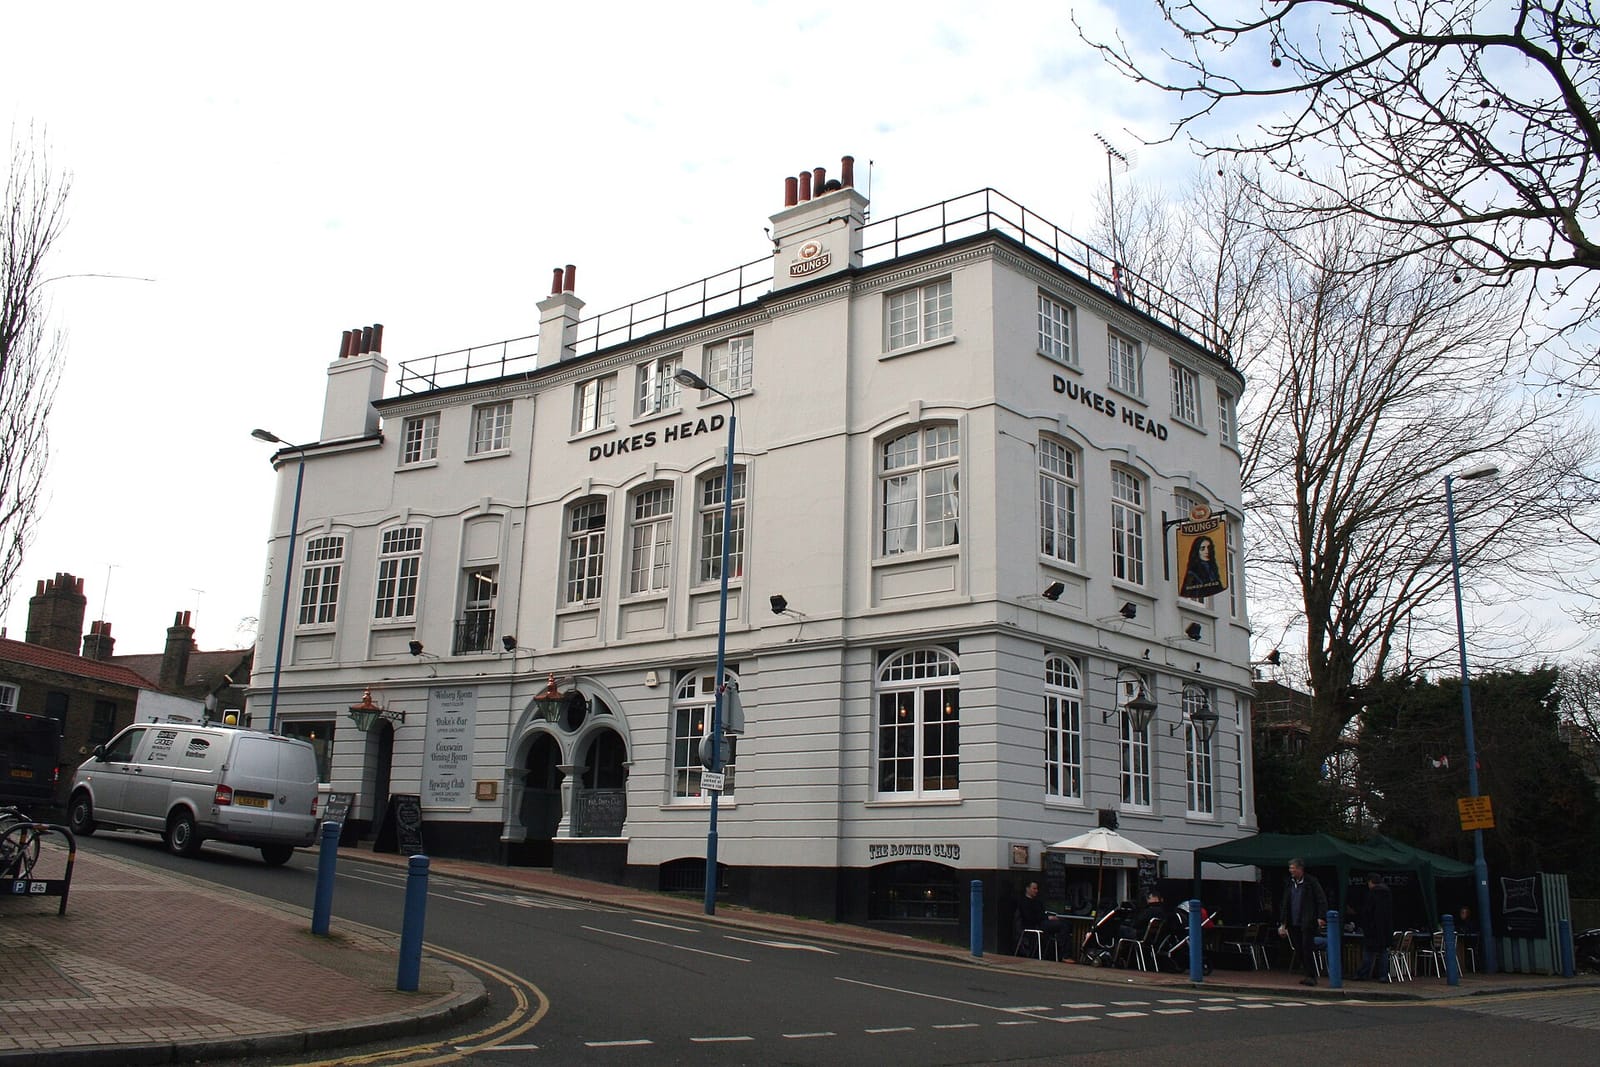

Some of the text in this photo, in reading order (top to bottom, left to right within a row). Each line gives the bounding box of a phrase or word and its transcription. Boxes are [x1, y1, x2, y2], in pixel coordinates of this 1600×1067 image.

[1053, 374, 1168, 441] DUKES HEAD
[589, 414, 725, 462] DUKES HEAD
[456, 690, 473, 701] Room
[436, 716, 468, 726] Duke's Bar
[451, 752, 468, 764] Room
[451, 778, 465, 788] Club
[869, 844, 960, 860] THE ROWING CLUB
[16, 882, 24, 891] P
